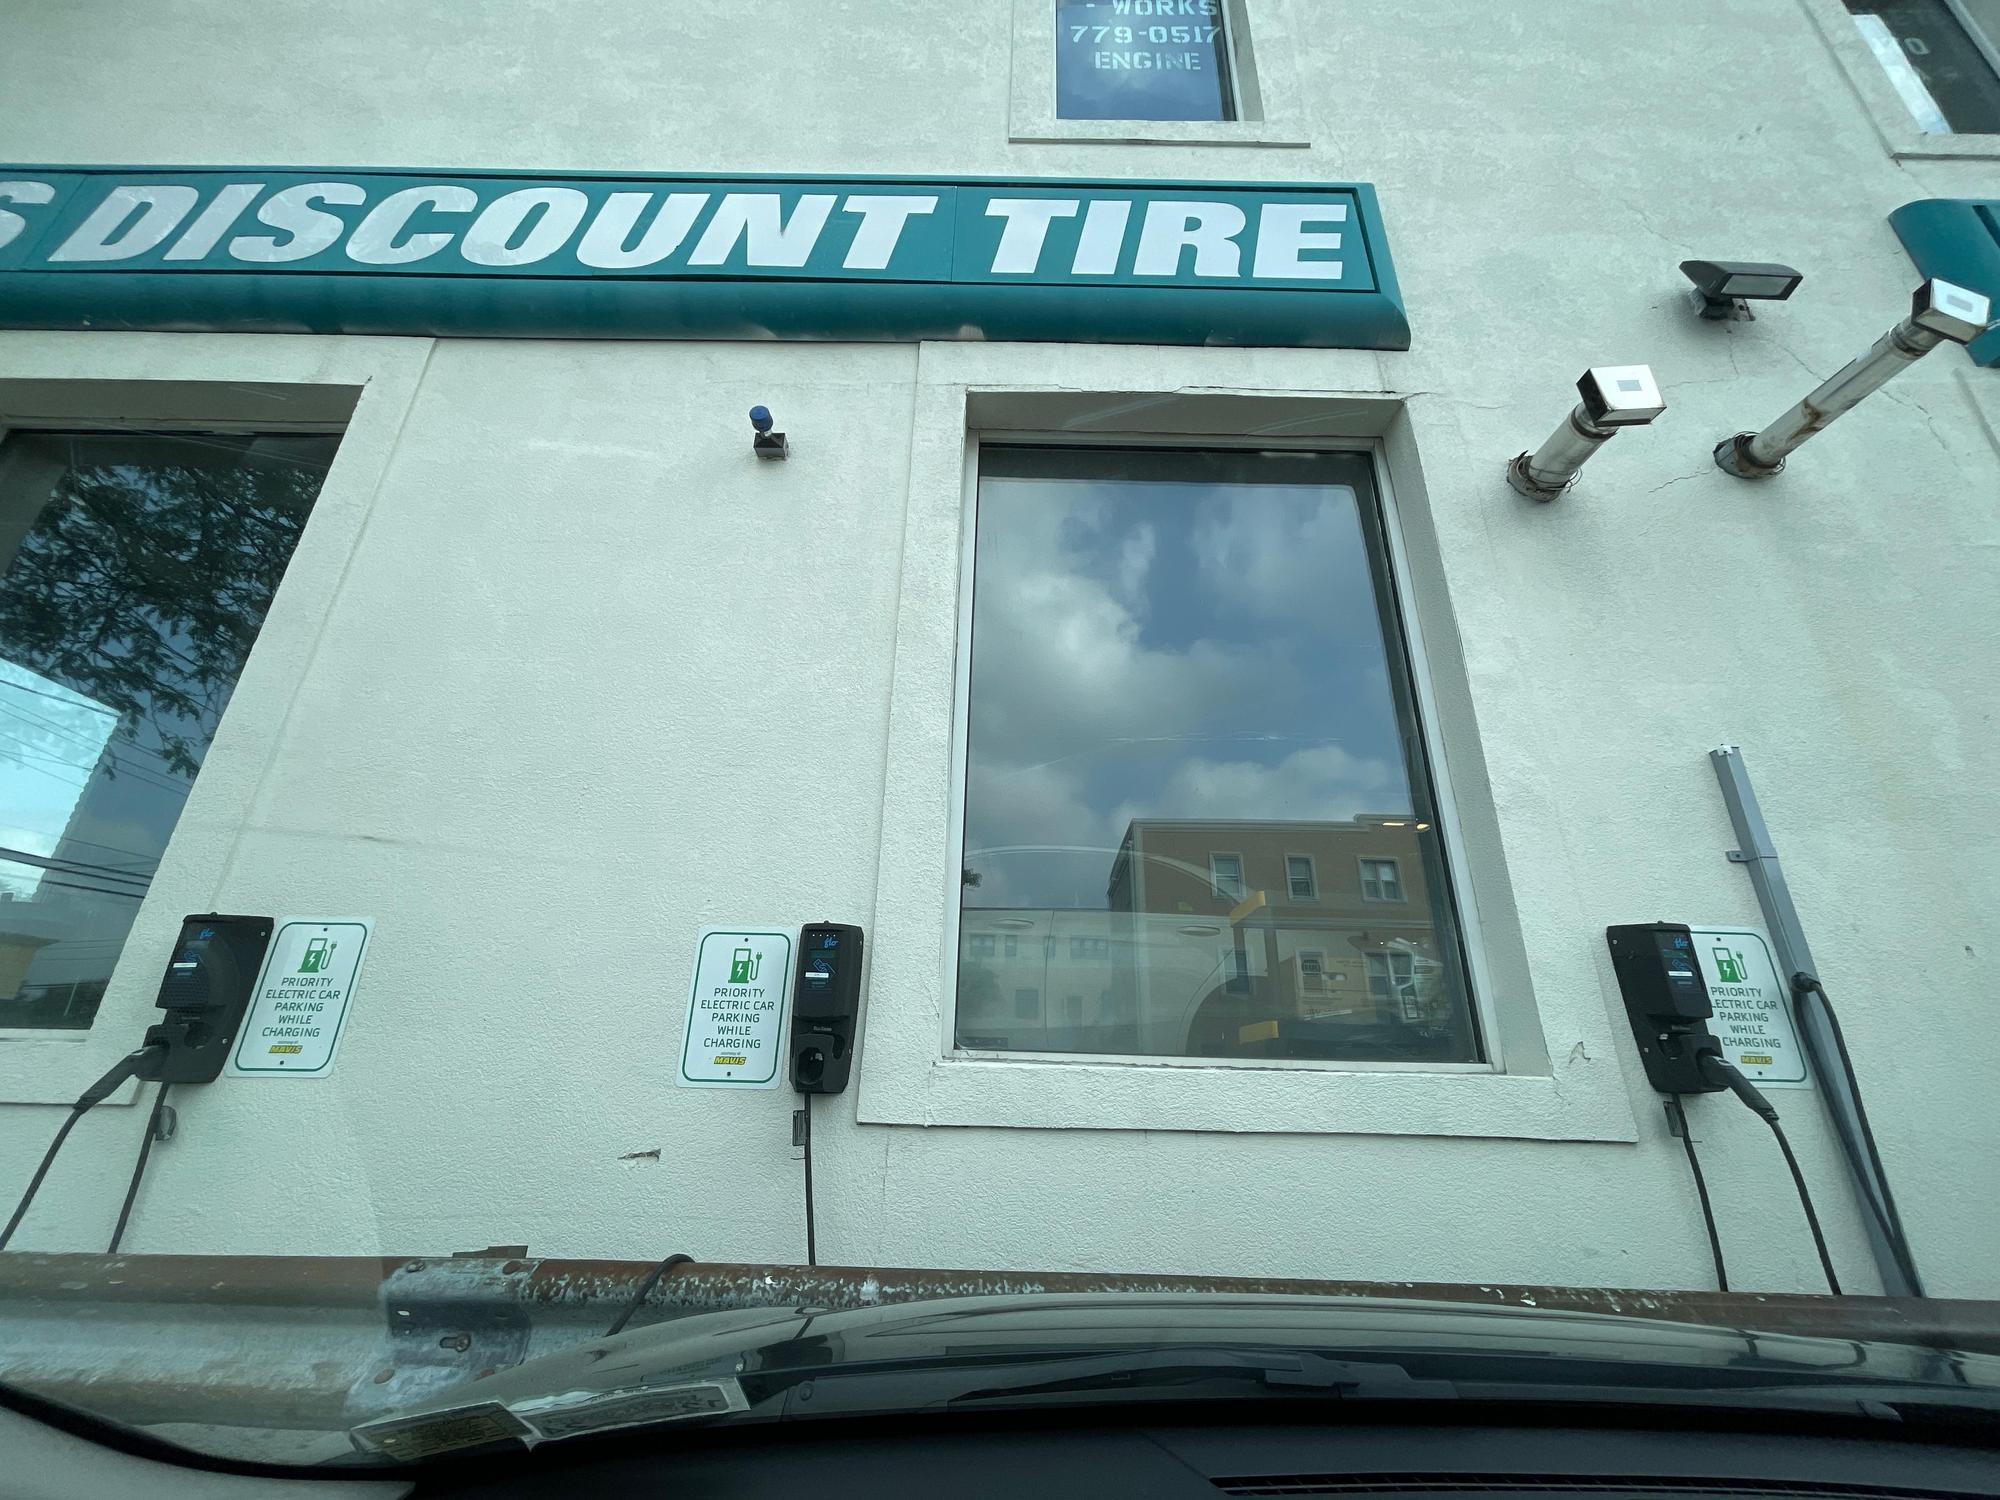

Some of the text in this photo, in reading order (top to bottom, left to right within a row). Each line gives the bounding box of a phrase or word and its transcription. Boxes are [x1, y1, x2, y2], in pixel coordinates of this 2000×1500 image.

[1113, 0, 1218, 17] WORKS
[1070, 25, 1221, 44] 779-0517
[1094, 51, 1201, 71] ENGINE
[47, 182, 939, 271] DISCOUNT
[984, 198, 1348, 280] TIRE
[281, 977, 334, 987] PRIORITY
[265, 989, 341, 1000] ELECTRIC CAR
[713, 987, 765, 998] PRIORITY
[1711, 987, 1762, 997] PRIORITY
[274, 1002, 324, 1012] PARKING
[700, 1000, 775, 1011] ELECTRIC CAR
[1711, 999, 1778, 1010] ECTRIC CAR
[278, 1014, 313, 1025] WHILE
[711, 1013, 760, 1023] PARKING
[1719, 1012, 1769, 1022] PARKING
[262, 1027, 321, 1037] CHARGING
[717, 1026, 751, 1036] WHILE
[1730, 1025, 1766, 1035] WHILE
[703, 1038, 761, 1049] CHARGING
[1722, 1037, 1781, 1049] CHARGING
[268, 1045, 303, 1054] MAVIS
[713, 1056, 747, 1065] MAVIS
[1740, 1055, 1773, 1065] MAVIS
